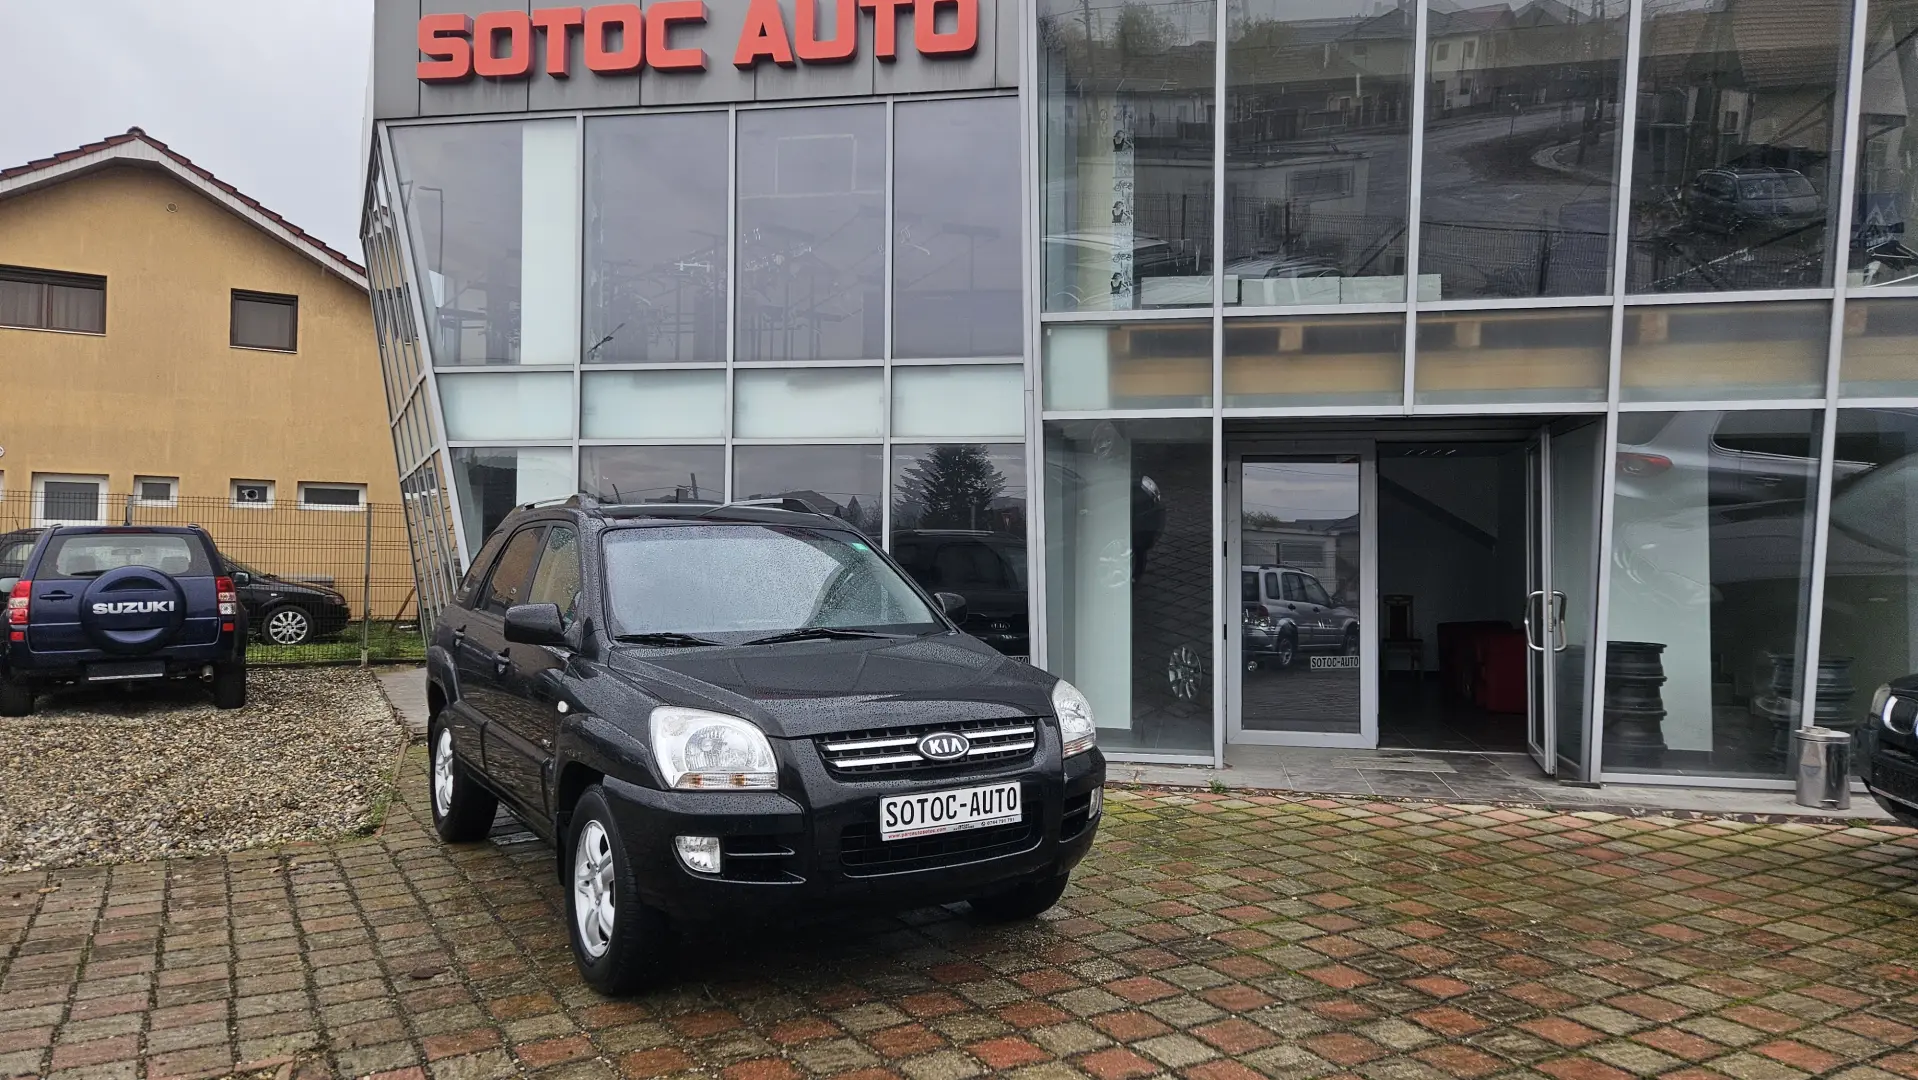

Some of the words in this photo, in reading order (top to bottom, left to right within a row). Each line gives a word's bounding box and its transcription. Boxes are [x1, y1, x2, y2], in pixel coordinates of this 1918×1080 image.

[416, 0, 708, 84] SOTOC
[732, 0, 980, 71] AUTO
[92, 600, 175, 615] SUZUKI
[1311, 656, 1359, 668] SOTOC-AUTO
[928, 739, 963, 755] KIA
[886, 786, 1017, 827] SOTOC-AUTO
